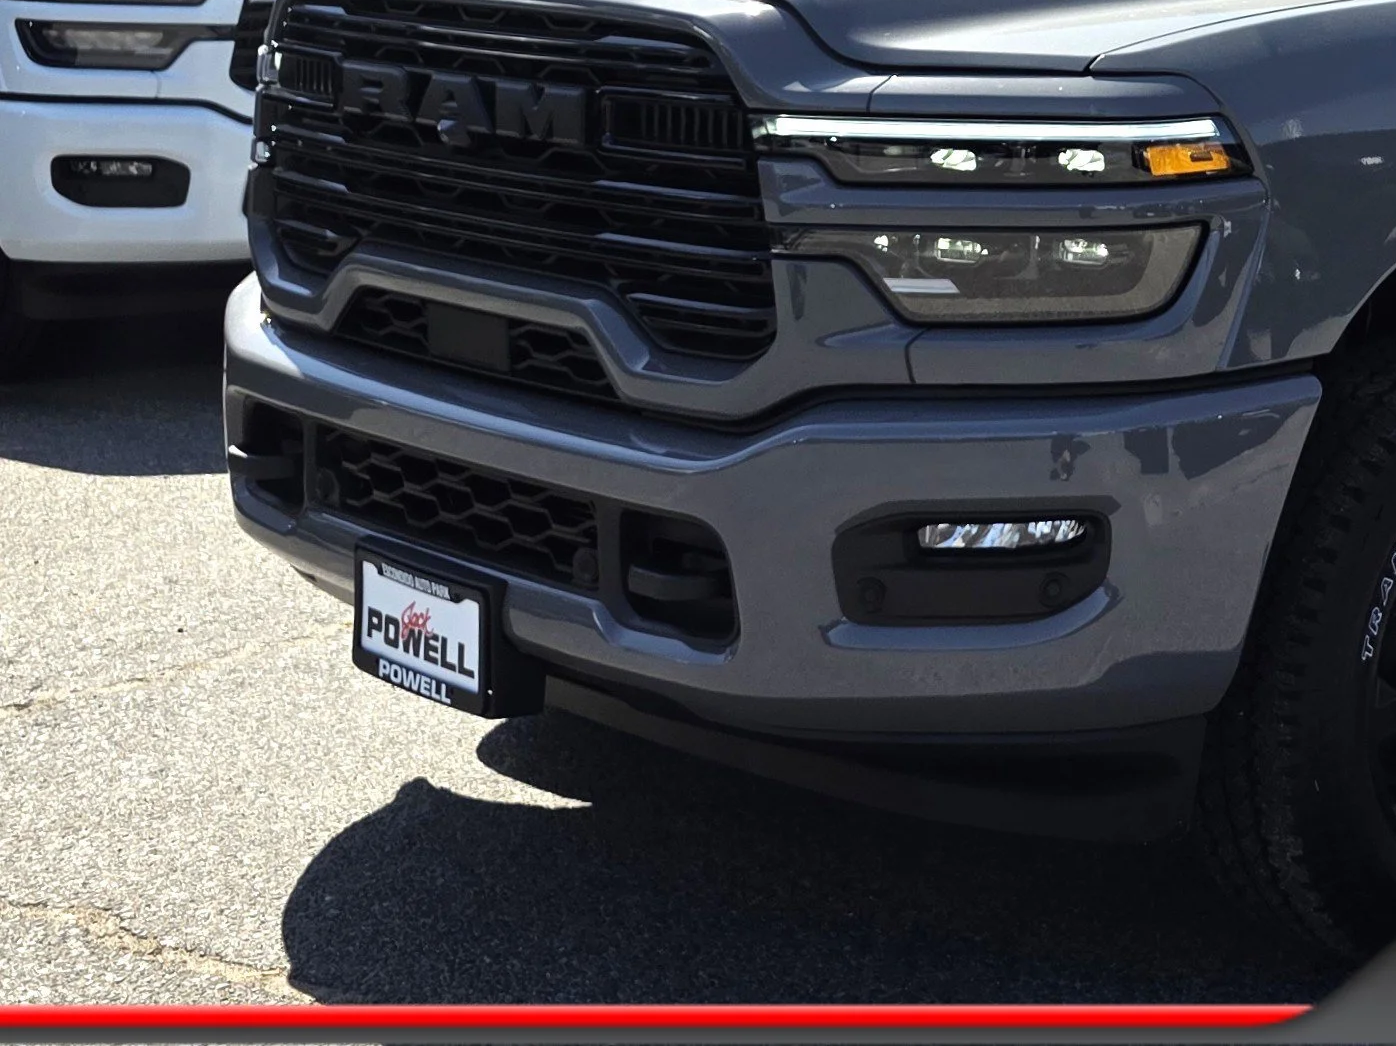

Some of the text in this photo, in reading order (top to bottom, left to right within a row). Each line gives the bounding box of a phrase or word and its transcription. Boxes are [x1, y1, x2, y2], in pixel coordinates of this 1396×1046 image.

[339, 58, 586, 148] RAM
[367, 606, 475, 680] POWELL
[378, 658, 451, 705] POWELL
